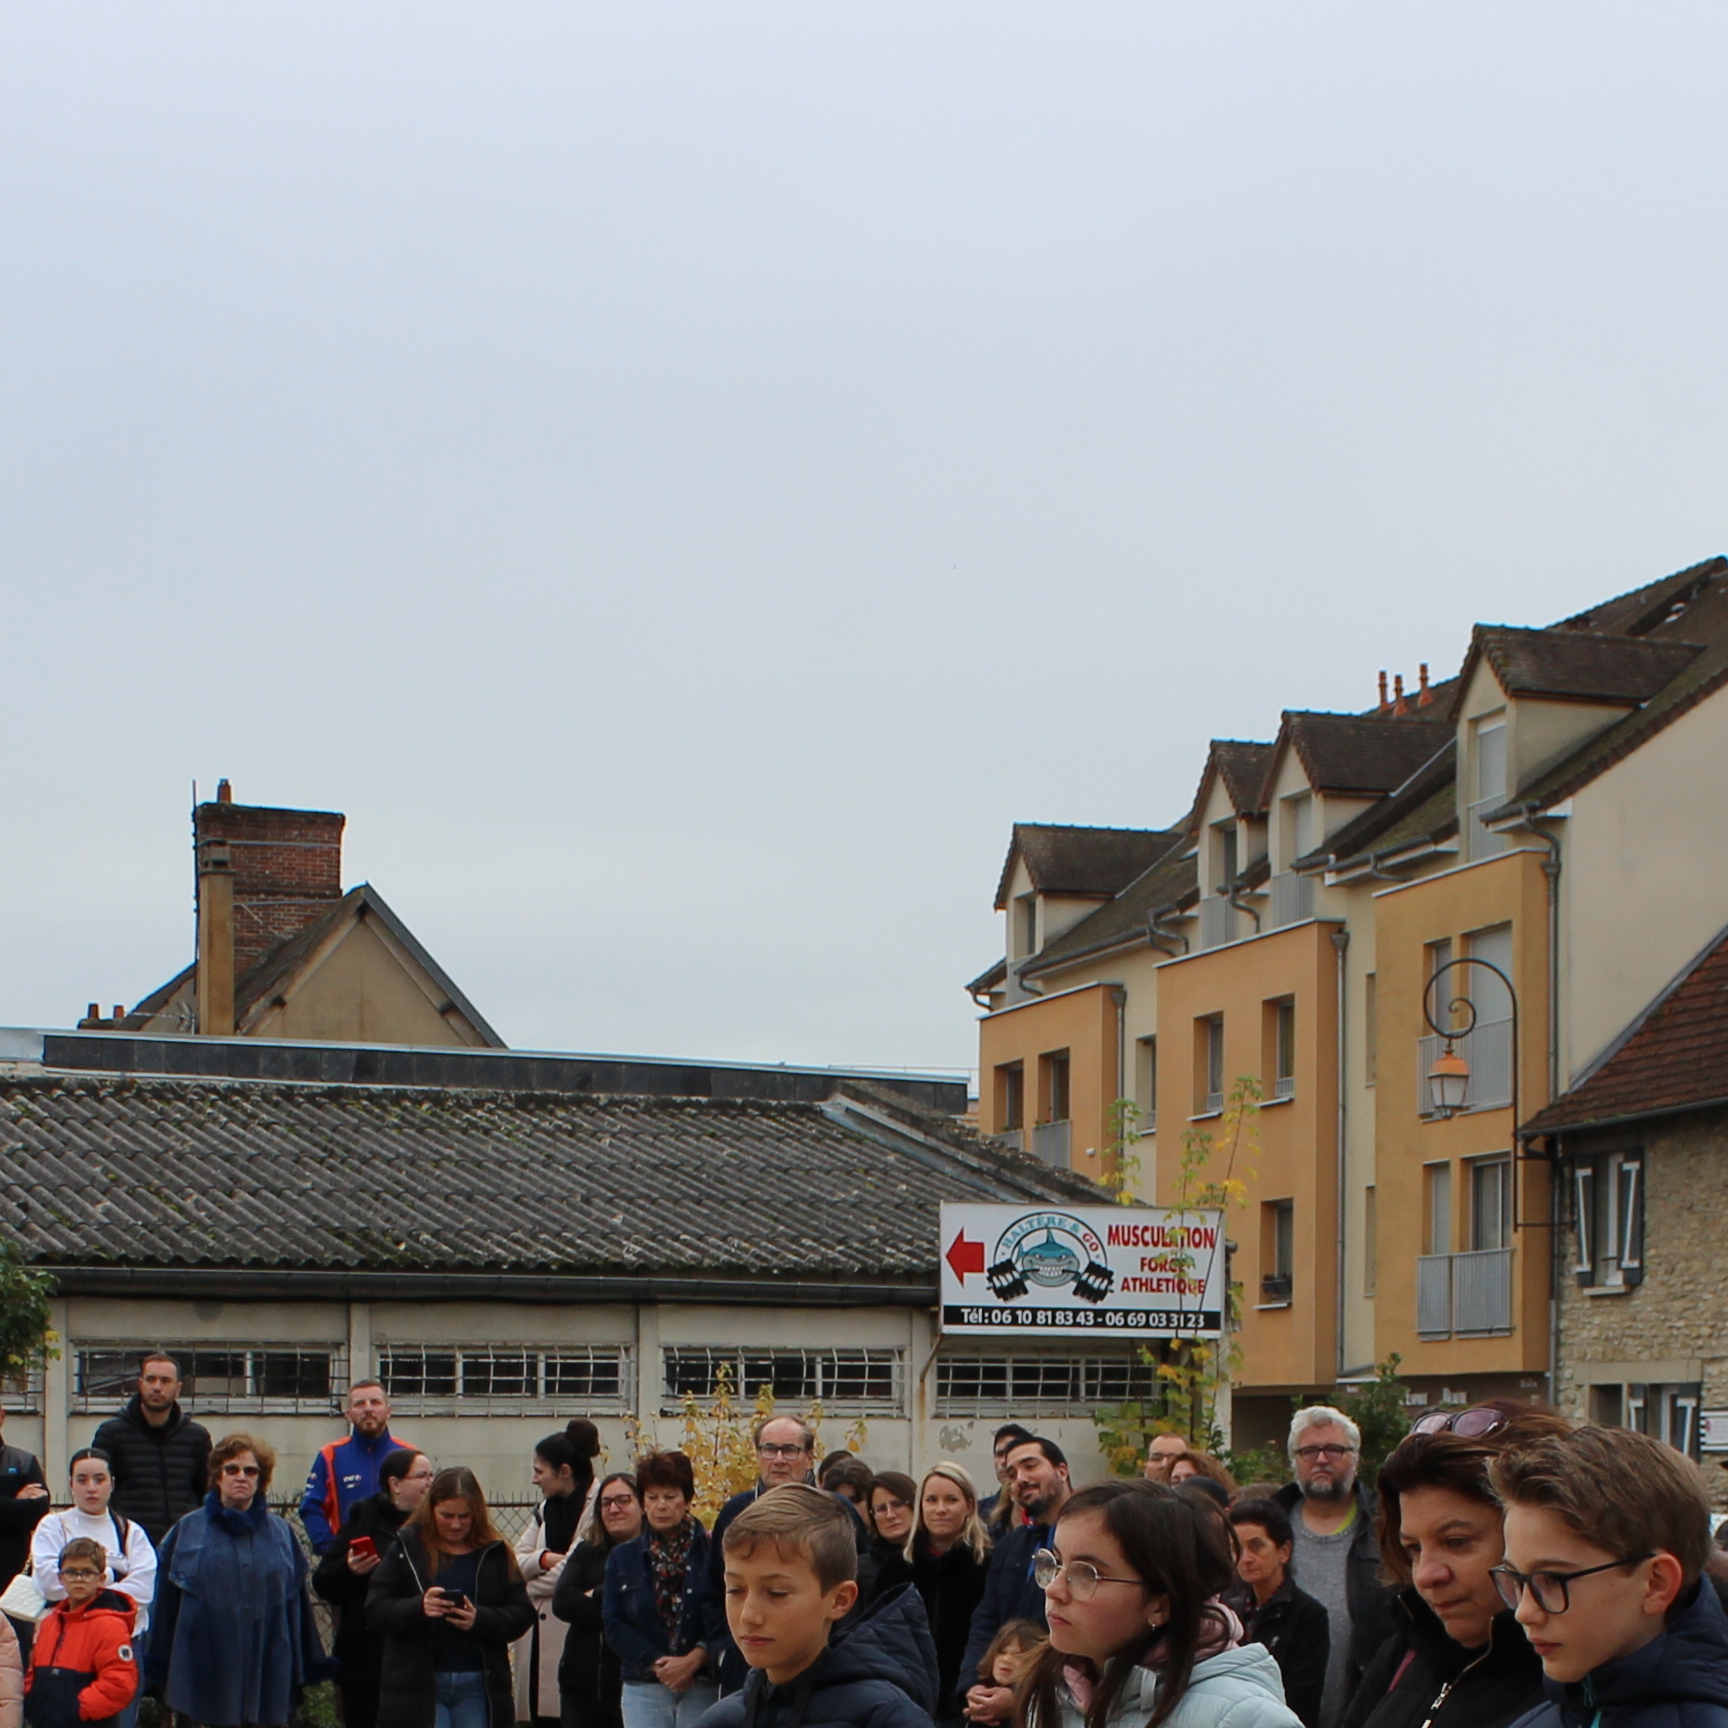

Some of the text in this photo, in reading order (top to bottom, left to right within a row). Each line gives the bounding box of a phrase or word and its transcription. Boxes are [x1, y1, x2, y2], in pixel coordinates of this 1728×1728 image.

[1082, 1233, 1100, 1252] GO
[1140, 1257, 1186, 1273] FORC
[991, 1309, 1012, 1325] 06
[1015, 1310, 1032, 1325] 10
[1036, 1310, 1052, 1326] 81
[1055, 1311, 1074, 1326] 83
[1076, 1311, 1095, 1326] 43
[1105, 1312, 1125, 1327] 06
[1127, 1312, 1147, 1328] 69
[1149, 1313, 1167, 1328] 03
[1169, 1313, 1185, 1328] 31
[1186, 1313, 1205, 1329] 23
